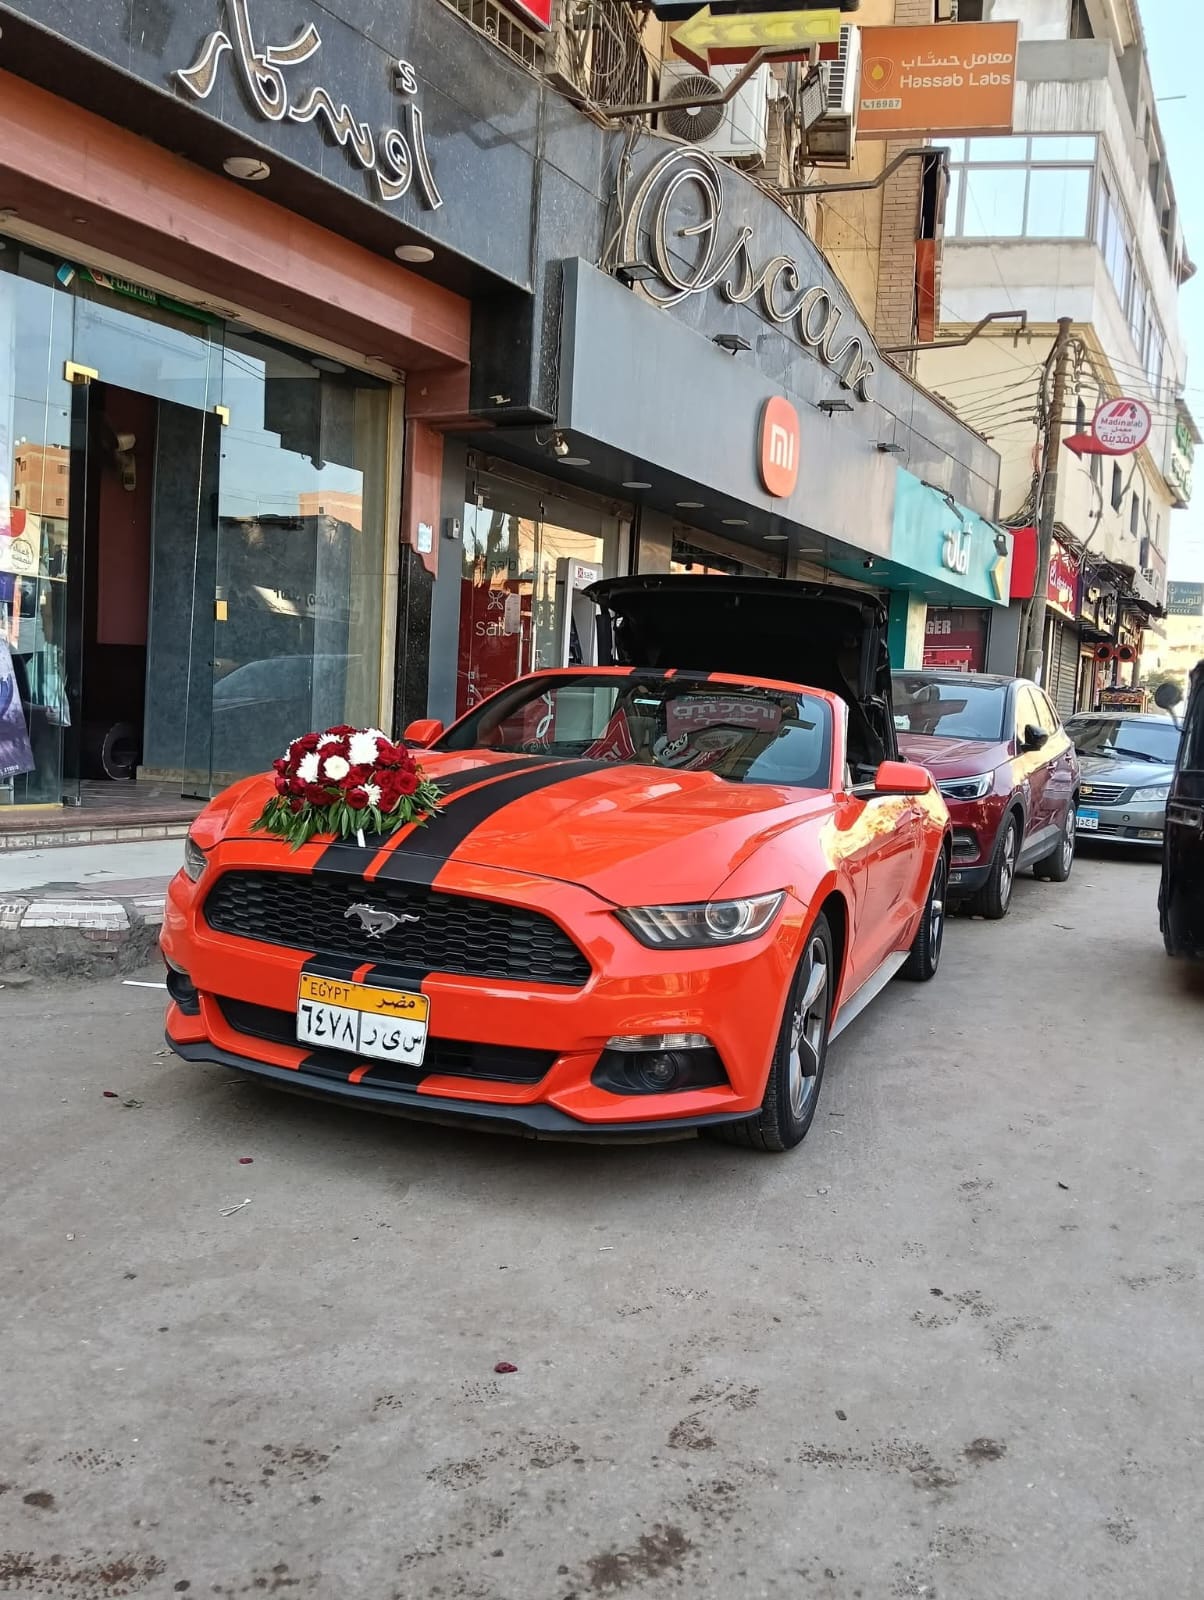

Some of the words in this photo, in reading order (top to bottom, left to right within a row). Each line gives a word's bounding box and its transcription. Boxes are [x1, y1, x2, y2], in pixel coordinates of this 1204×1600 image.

[963, 52, 1013, 69] معامل
[900, 73, 963, 88] Hassab
[968, 72, 1011, 86] Labs
[624, 145, 874, 402] Oscar
[1101, 432, 1137, 446] المدينة
[943, 521, 973, 575] أمان
[489, 556, 518, 571] saib
[310, 981, 350, 1002] EGYPT
[376, 998, 416, 1009] مصر
[302, 1004, 354, 1043] ٦٤٧٨
